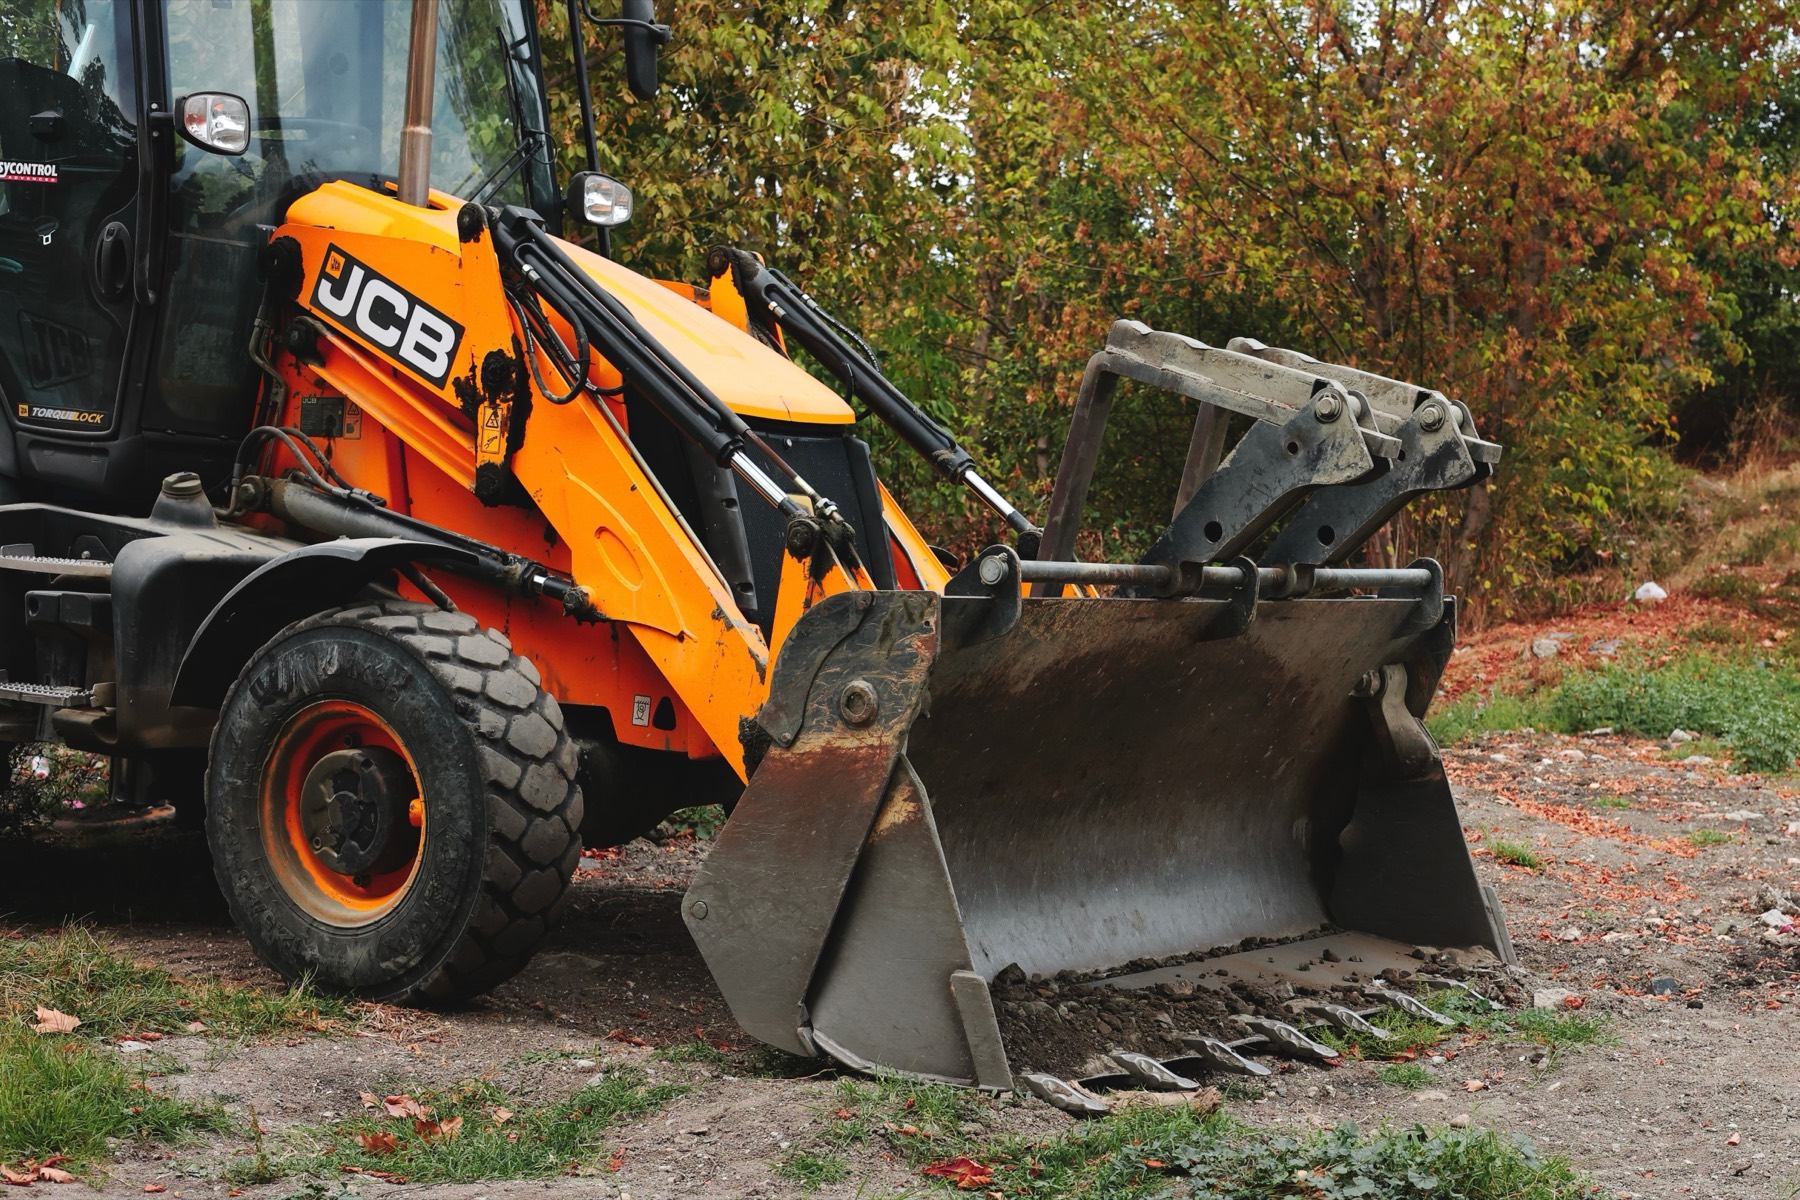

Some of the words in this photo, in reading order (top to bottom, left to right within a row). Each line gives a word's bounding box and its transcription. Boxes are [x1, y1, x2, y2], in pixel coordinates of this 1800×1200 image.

[330, 255, 341, 271] JCB
[317, 264, 456, 378] JCB
[31, 319, 90, 381] JCB
[32, 407, 103, 423] TORQUELOCK
